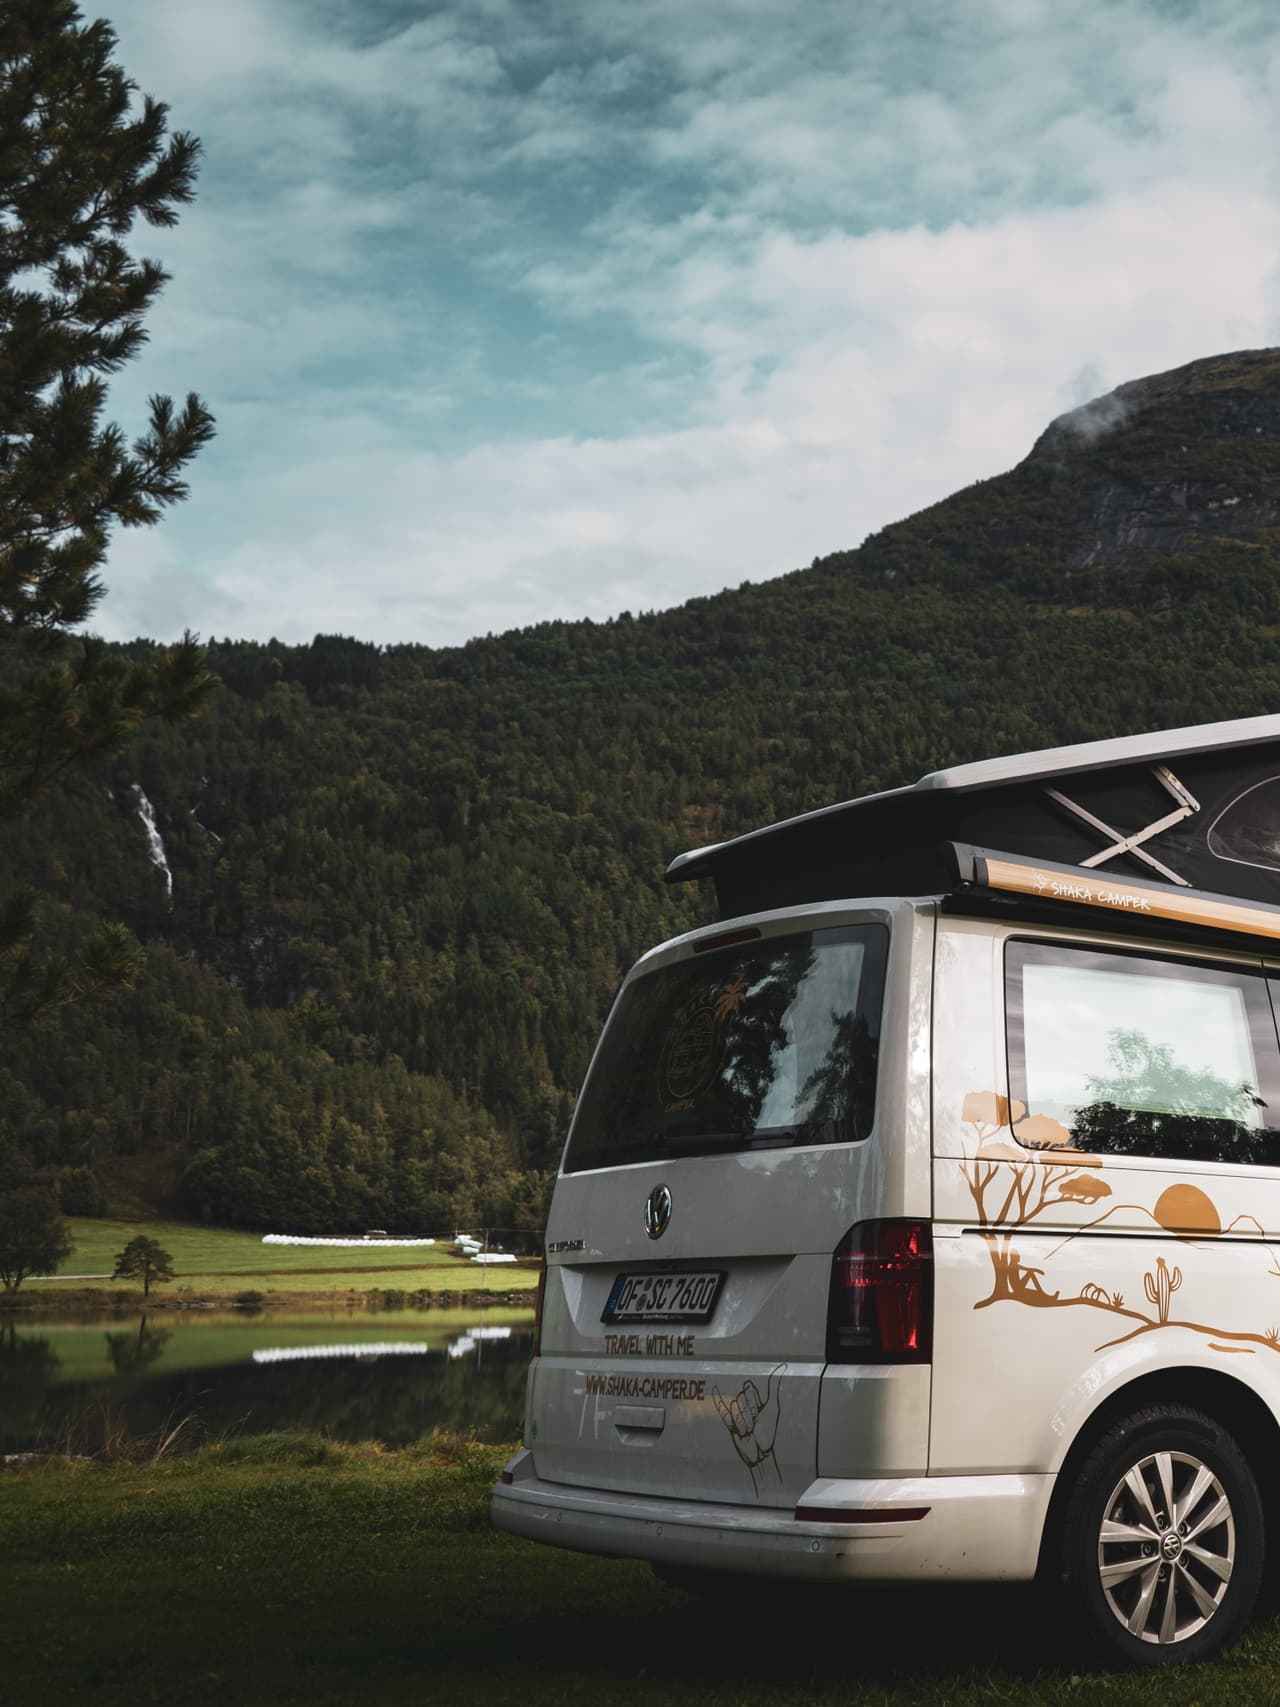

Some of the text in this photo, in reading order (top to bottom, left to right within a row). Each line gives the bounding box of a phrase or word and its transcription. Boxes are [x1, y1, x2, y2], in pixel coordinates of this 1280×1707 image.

[1050, 881, 1151, 911] SHAKA CAMPER
[617, 1277, 717, 1310] OF SC 7600
[604, 1334, 695, 1356] TRAVEL WITH ME
[585, 1374, 706, 1401] WWW.SHAKA-CAMPER.DE
